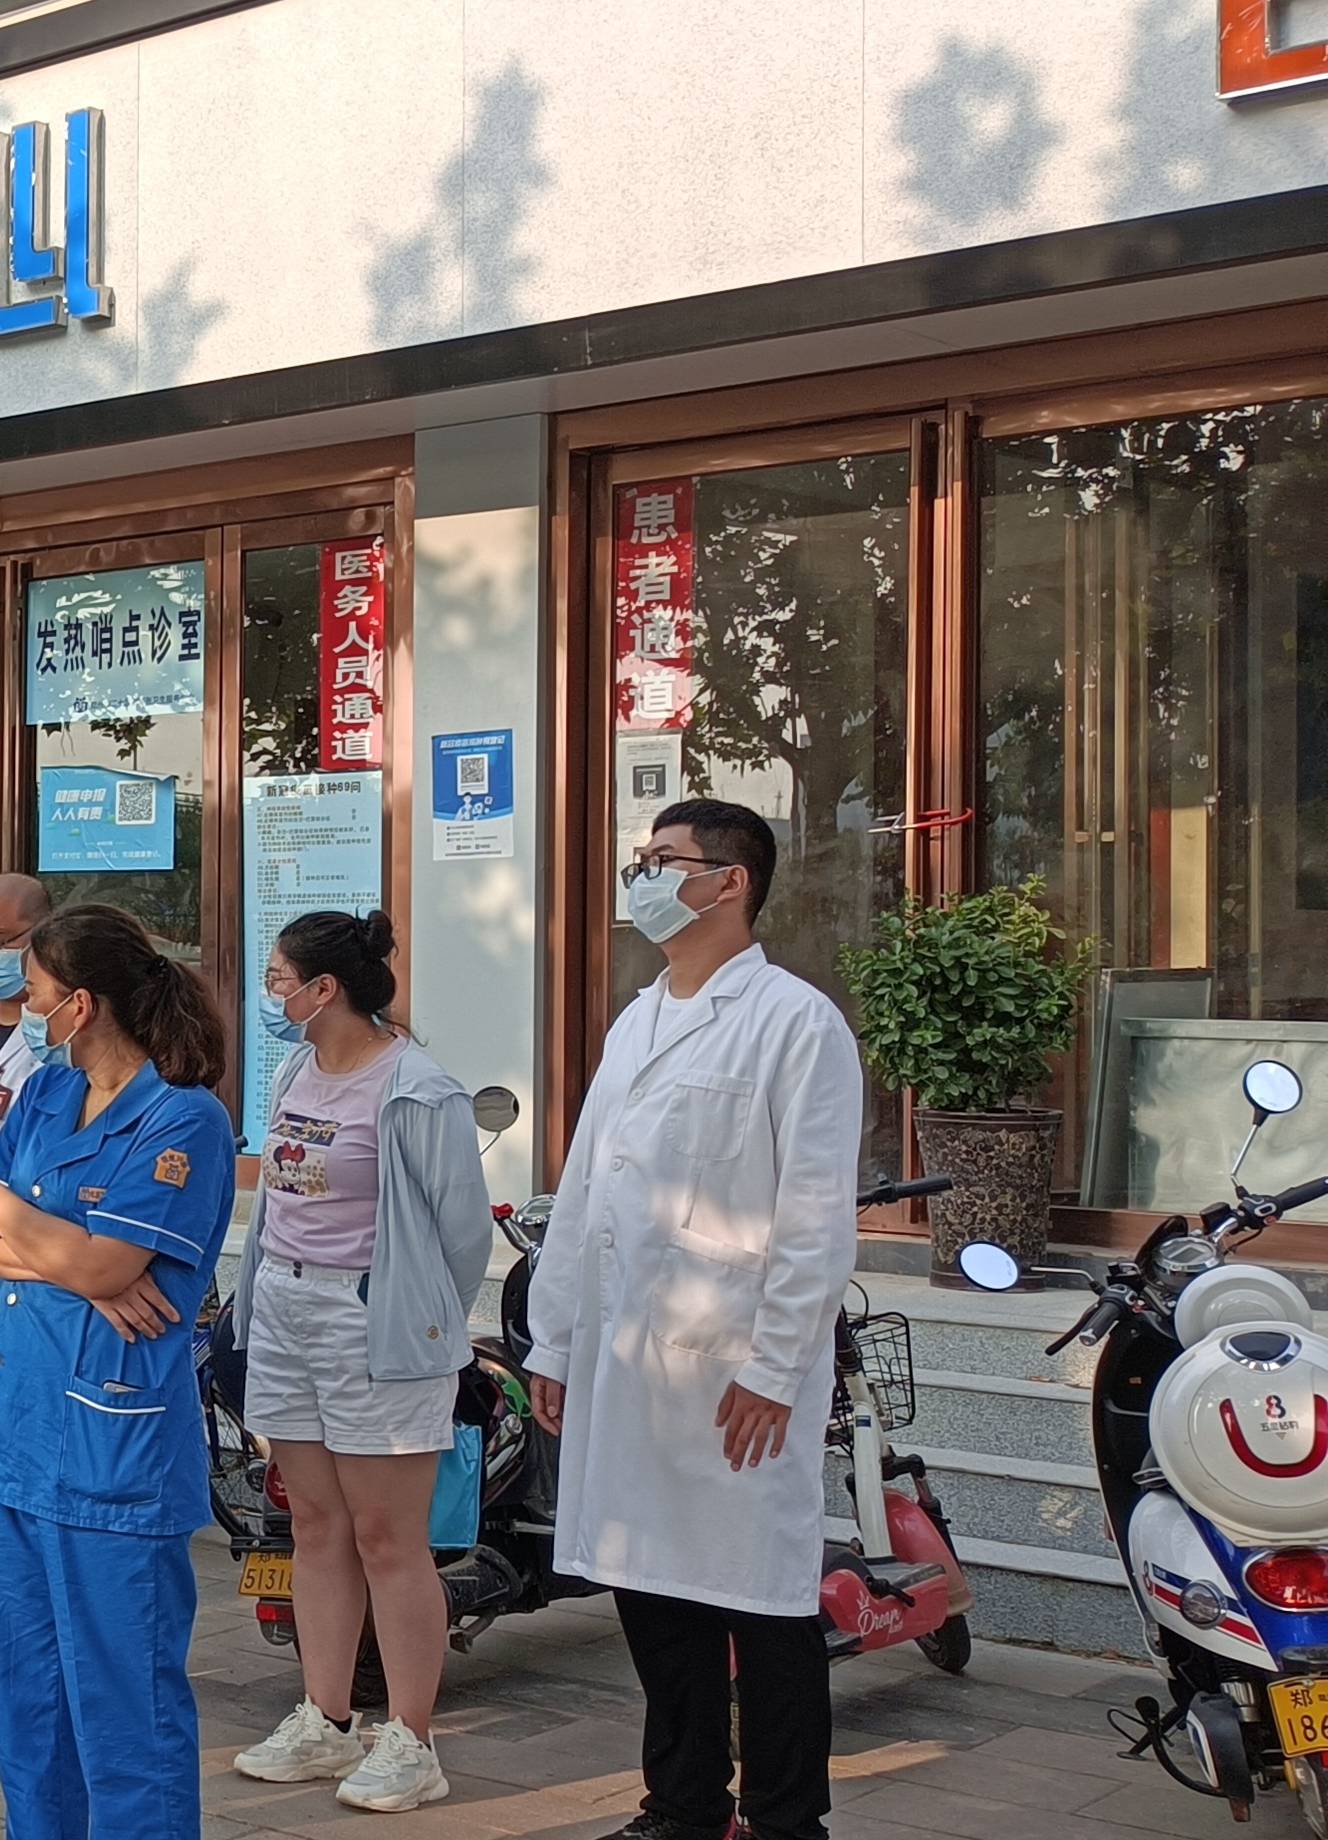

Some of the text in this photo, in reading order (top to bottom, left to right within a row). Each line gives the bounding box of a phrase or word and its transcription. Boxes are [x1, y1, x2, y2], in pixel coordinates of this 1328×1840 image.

[35, 604, 202, 676] 发热哨点诊室
[331, 549, 375, 761] 医务人员通道
[629, 492, 679, 720] 患者通道
[1289, 1688, 1314, 1709] 郑
